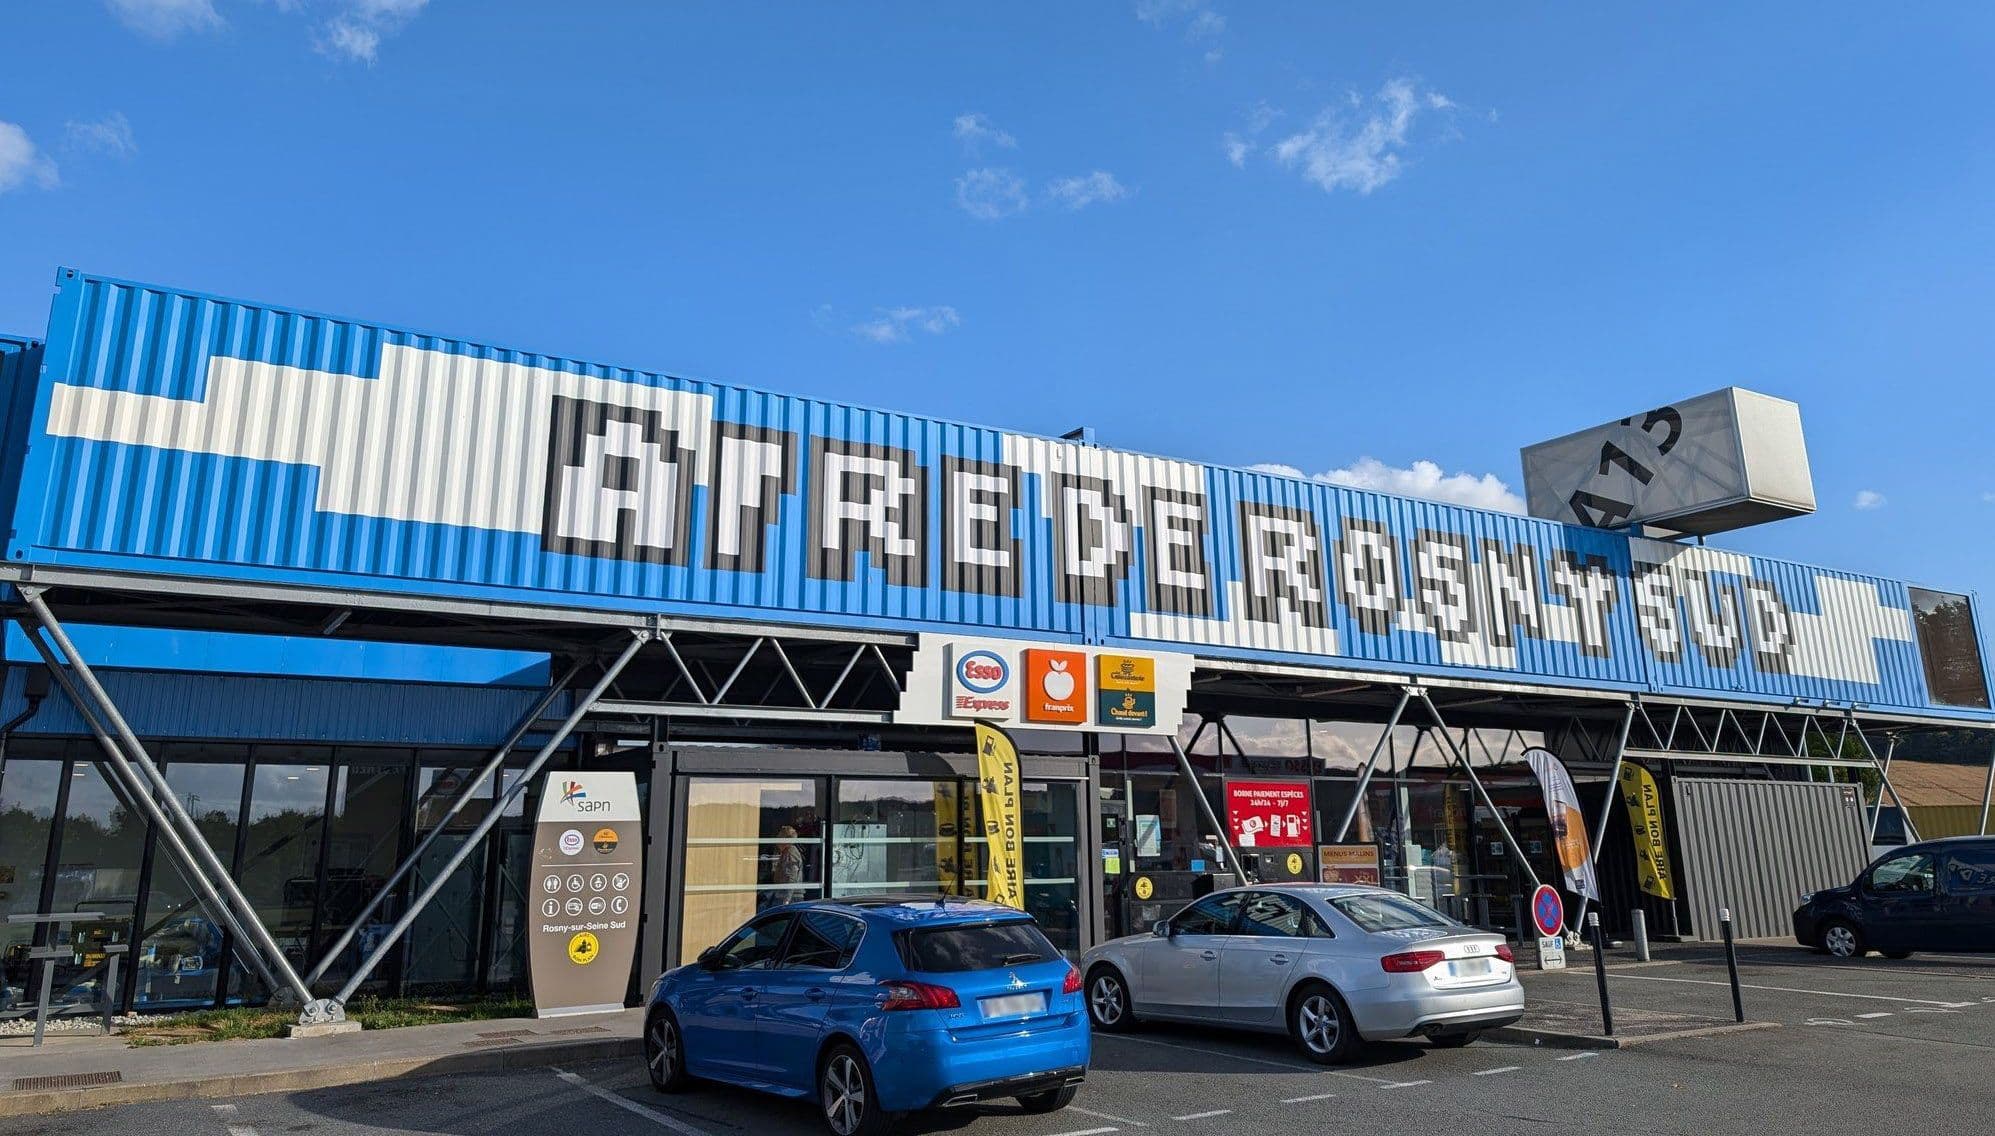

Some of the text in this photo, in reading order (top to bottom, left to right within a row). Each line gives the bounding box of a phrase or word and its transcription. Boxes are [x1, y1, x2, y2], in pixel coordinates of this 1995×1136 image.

[1057, 478, 1209, 606] DE
[1242, 505, 1615, 656] ROSNY
[1634, 565, 1794, 667] SUD
[966, 661, 1002, 680] Esso
[957, 696, 1010, 712] Express
[1045, 703, 1073, 712] franprix
[1253, 790, 1280, 798] PAIEMENT
[543, 921, 626, 933] Rosny-sur-Seine Sud
